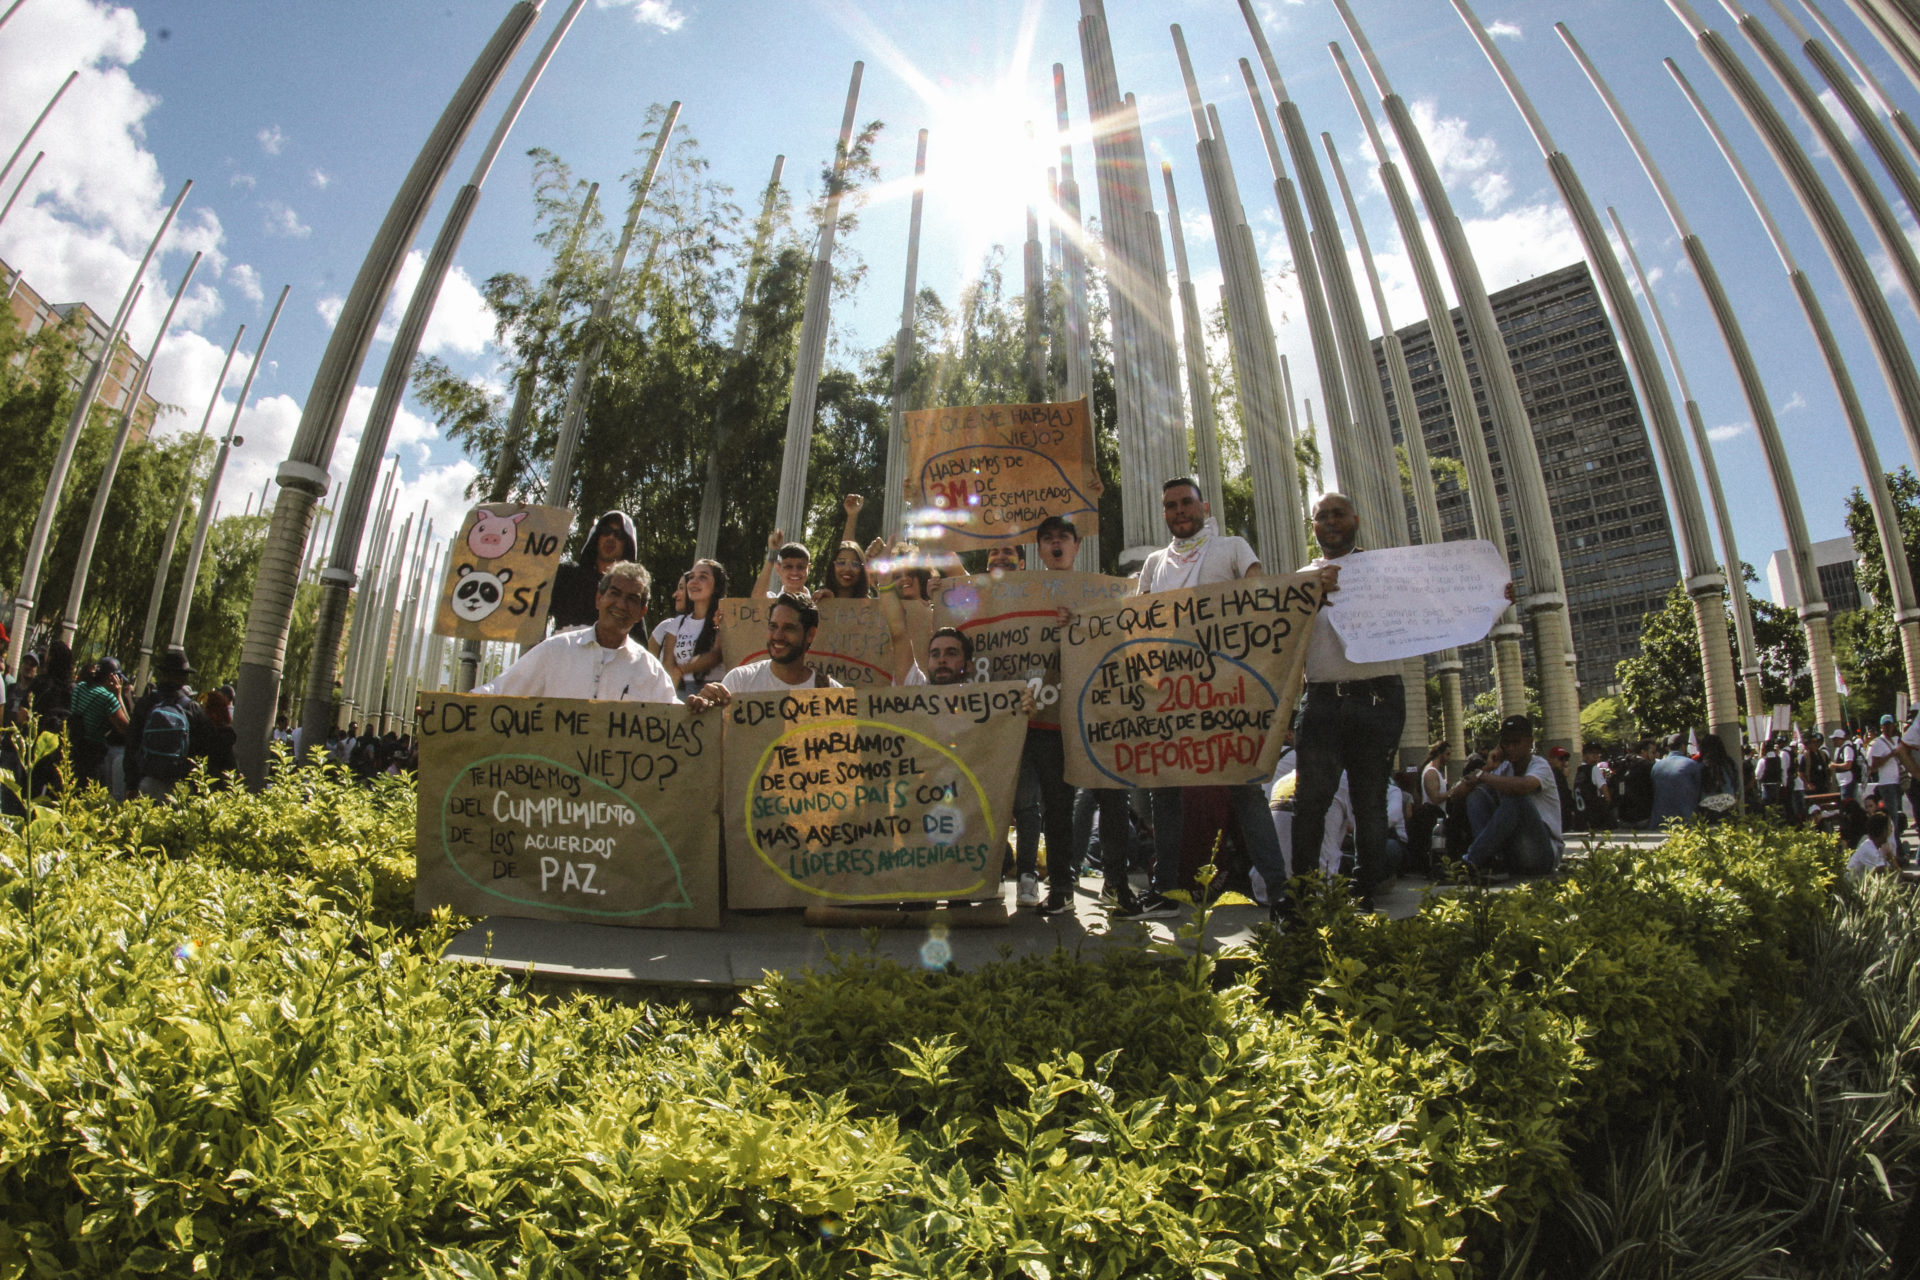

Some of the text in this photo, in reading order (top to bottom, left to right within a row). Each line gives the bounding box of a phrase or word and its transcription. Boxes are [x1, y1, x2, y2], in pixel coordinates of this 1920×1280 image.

[1011, 407, 1074, 427] HABLAS
[1000, 430, 1064, 446] VIEJO?
[929, 455, 1024, 482] HABLAMOS DE
[930, 478, 997, 510] 3M DE
[980, 487, 1072, 508] DESEMPLEADOS
[983, 507, 1049, 525] COLOMBIA
[524, 532, 558, 556] NO
[508, 581, 548, 617] SÍ
[1067, 614, 1115, 646] ¿DE
[1116, 600, 1167, 633] QUÉ
[1174, 597, 1214, 628] ME
[1221, 582, 1316, 616] HABLAS
[1041, 627, 1061, 643] DE
[1195, 618, 1291, 660] VIEJO?
[1100, 649, 1217, 688] TE HABLAMOS
[733, 688, 1021, 726] ¿DE QUÉ ME HABLAS VIEJO?
[1091, 689, 1111, 705] DE
[1120, 684, 1146, 711] LAS
[421, 700, 704, 757] ¿DE QUÉ ME HABLAS
[1087, 709, 1276, 744] HECTAREAS DE BOSQUE
[577, 745, 678, 791] VIEJO?
[773, 732, 906, 770] TE HABLAMOS
[469, 763, 581, 797] TE HABLAMOS
[760, 757, 924, 793] DE QUE SOMOS EL
[450, 790, 636, 830] DEL CUMPLIMIENTO
[752, 780, 958, 819] SEGUNDO PAÍS CON
[450, 826, 616, 860] DE LOS ACUERDOS
[755, 814, 954, 850] MÁS ASESINATO DE
[493, 856, 607, 895] DE PAZ.
[788, 843, 989, 881] LÍDERES AMBIENTALES
